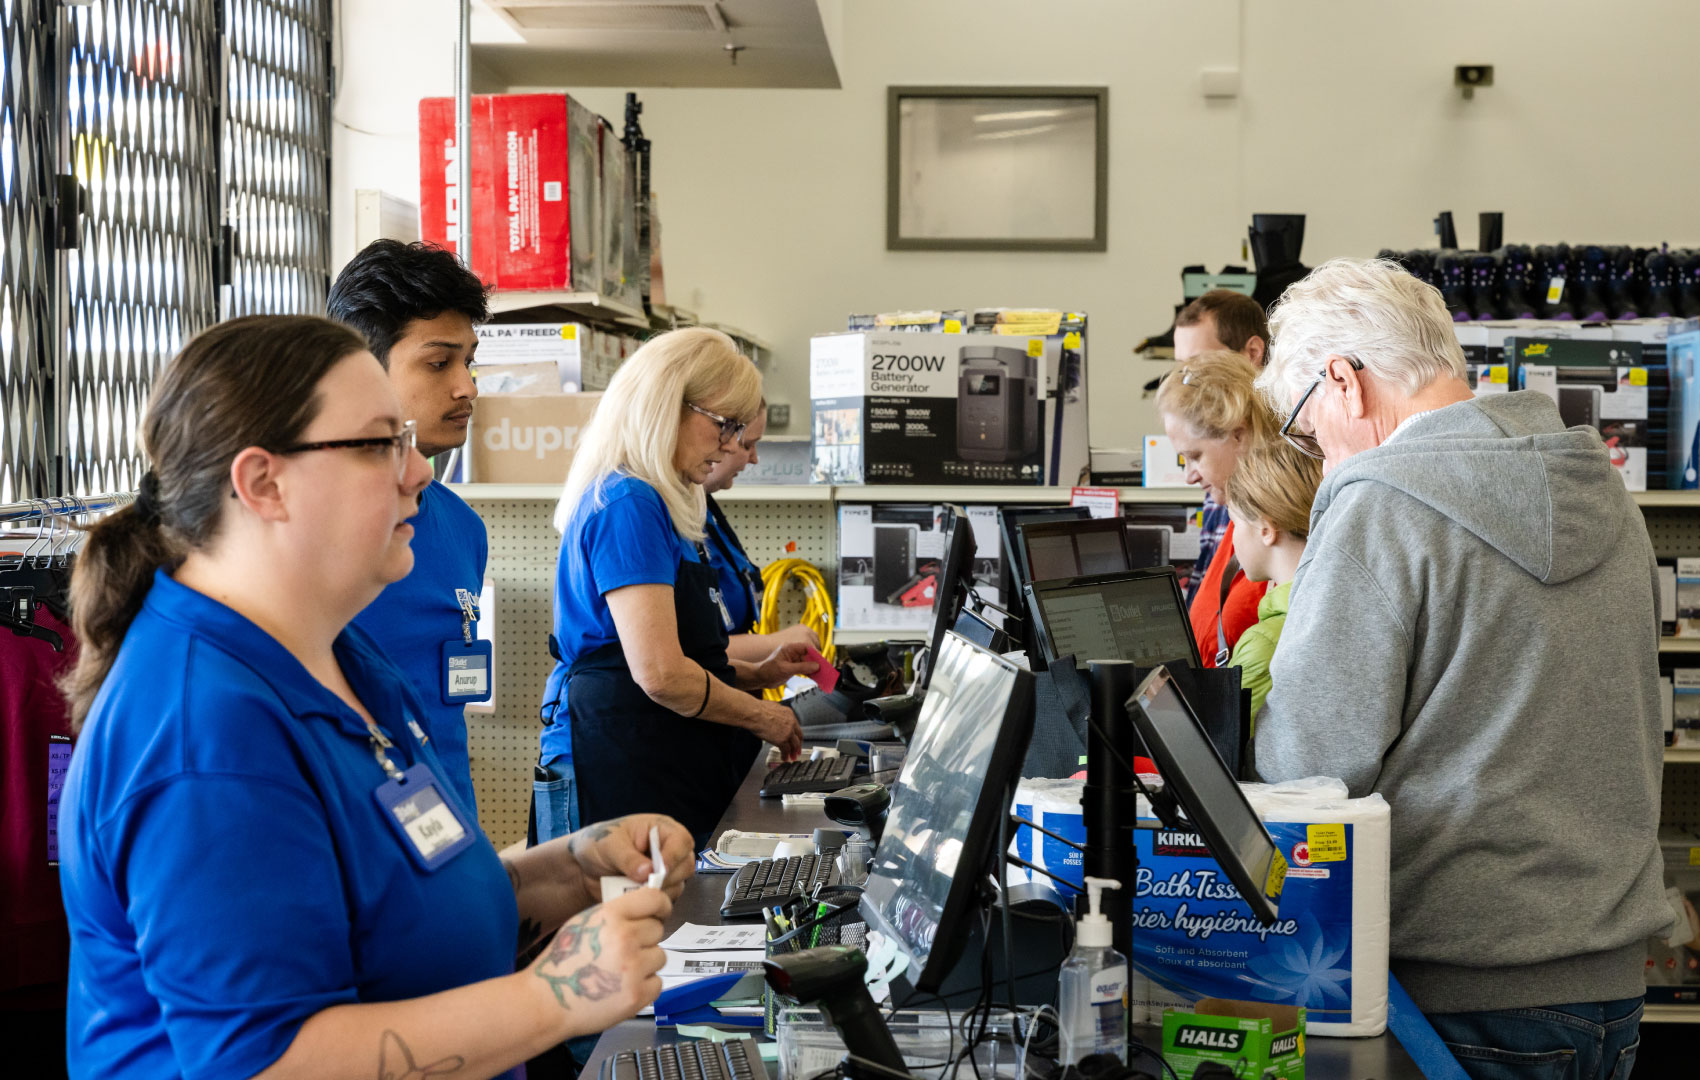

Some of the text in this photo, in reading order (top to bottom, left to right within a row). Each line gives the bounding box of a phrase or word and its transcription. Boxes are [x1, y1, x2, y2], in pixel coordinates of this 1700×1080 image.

[474, 329, 494, 338] TAL
[520, 328, 562, 337] FREEDO
[871, 354, 945, 372] 2700W
[870, 371, 914, 384] Battery
[870, 381, 930, 393] Generator
[483, 417, 579, 460] dupr
[760, 463, 804, 476] PLUS
[1157, 832, 1206, 847] KIRKL
[1136, 868, 1196, 897] Bath
[1195, 870, 1242, 899] Tiss
[1155, 945, 1249, 959] Soft and Absorbent
[1157, 956, 1247, 969] Doux et absorbant
[1180, 1028, 1240, 1049] HALLS
[1271, 1035, 1297, 1055] HALLS
